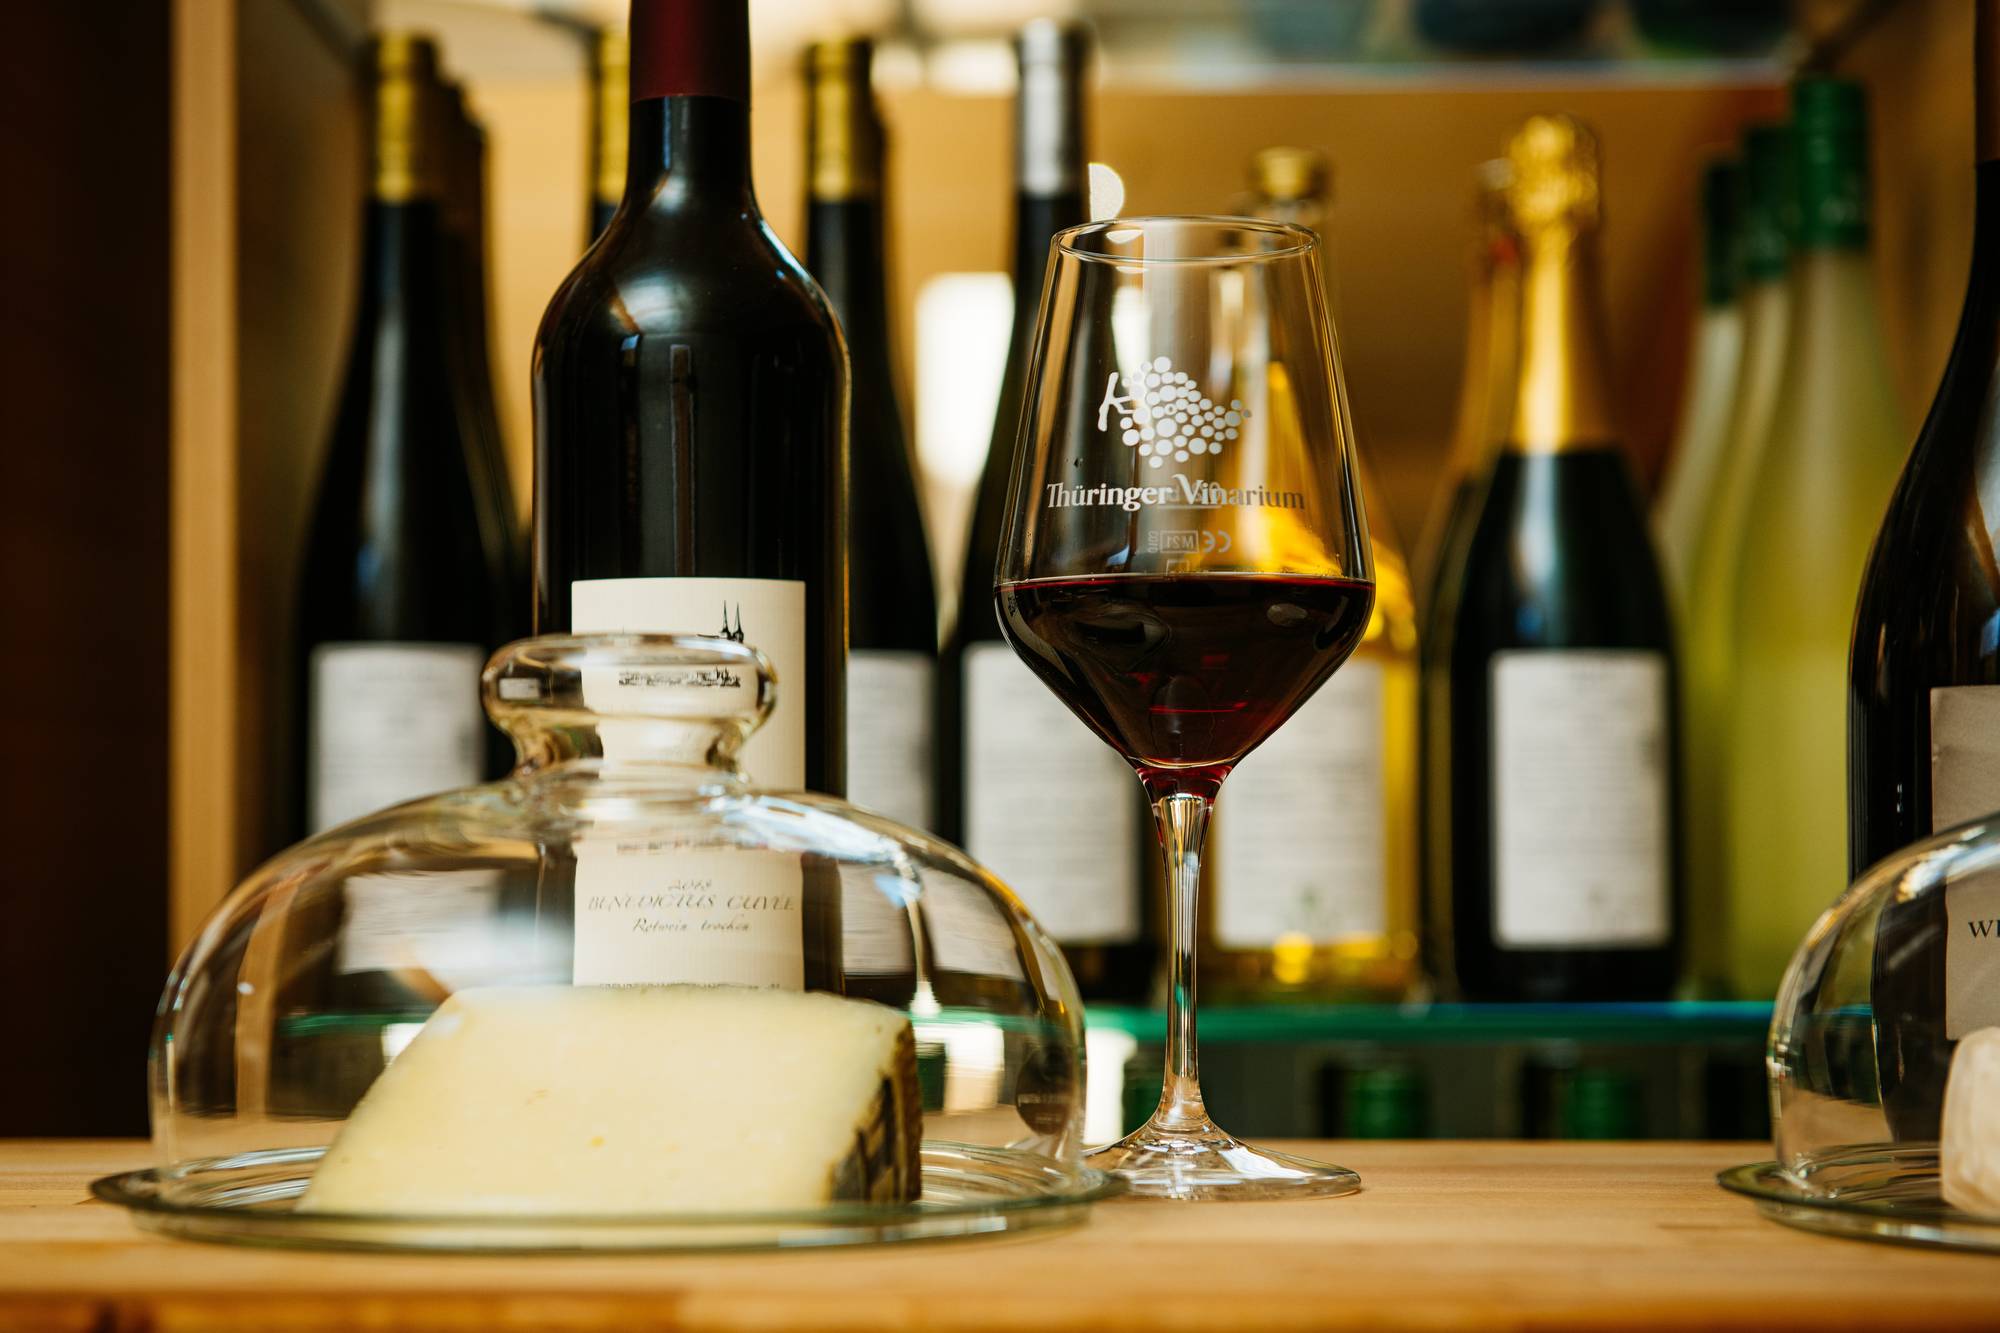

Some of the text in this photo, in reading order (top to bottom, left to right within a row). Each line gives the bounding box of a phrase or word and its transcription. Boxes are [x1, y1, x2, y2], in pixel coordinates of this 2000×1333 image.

[1047, 482, 1174, 511] Thüringer
[1170, 473, 1305, 510] Vinarium
[632, 914, 750, 936] Rotwein trocken
[1967, 919, 2000, 938] W
